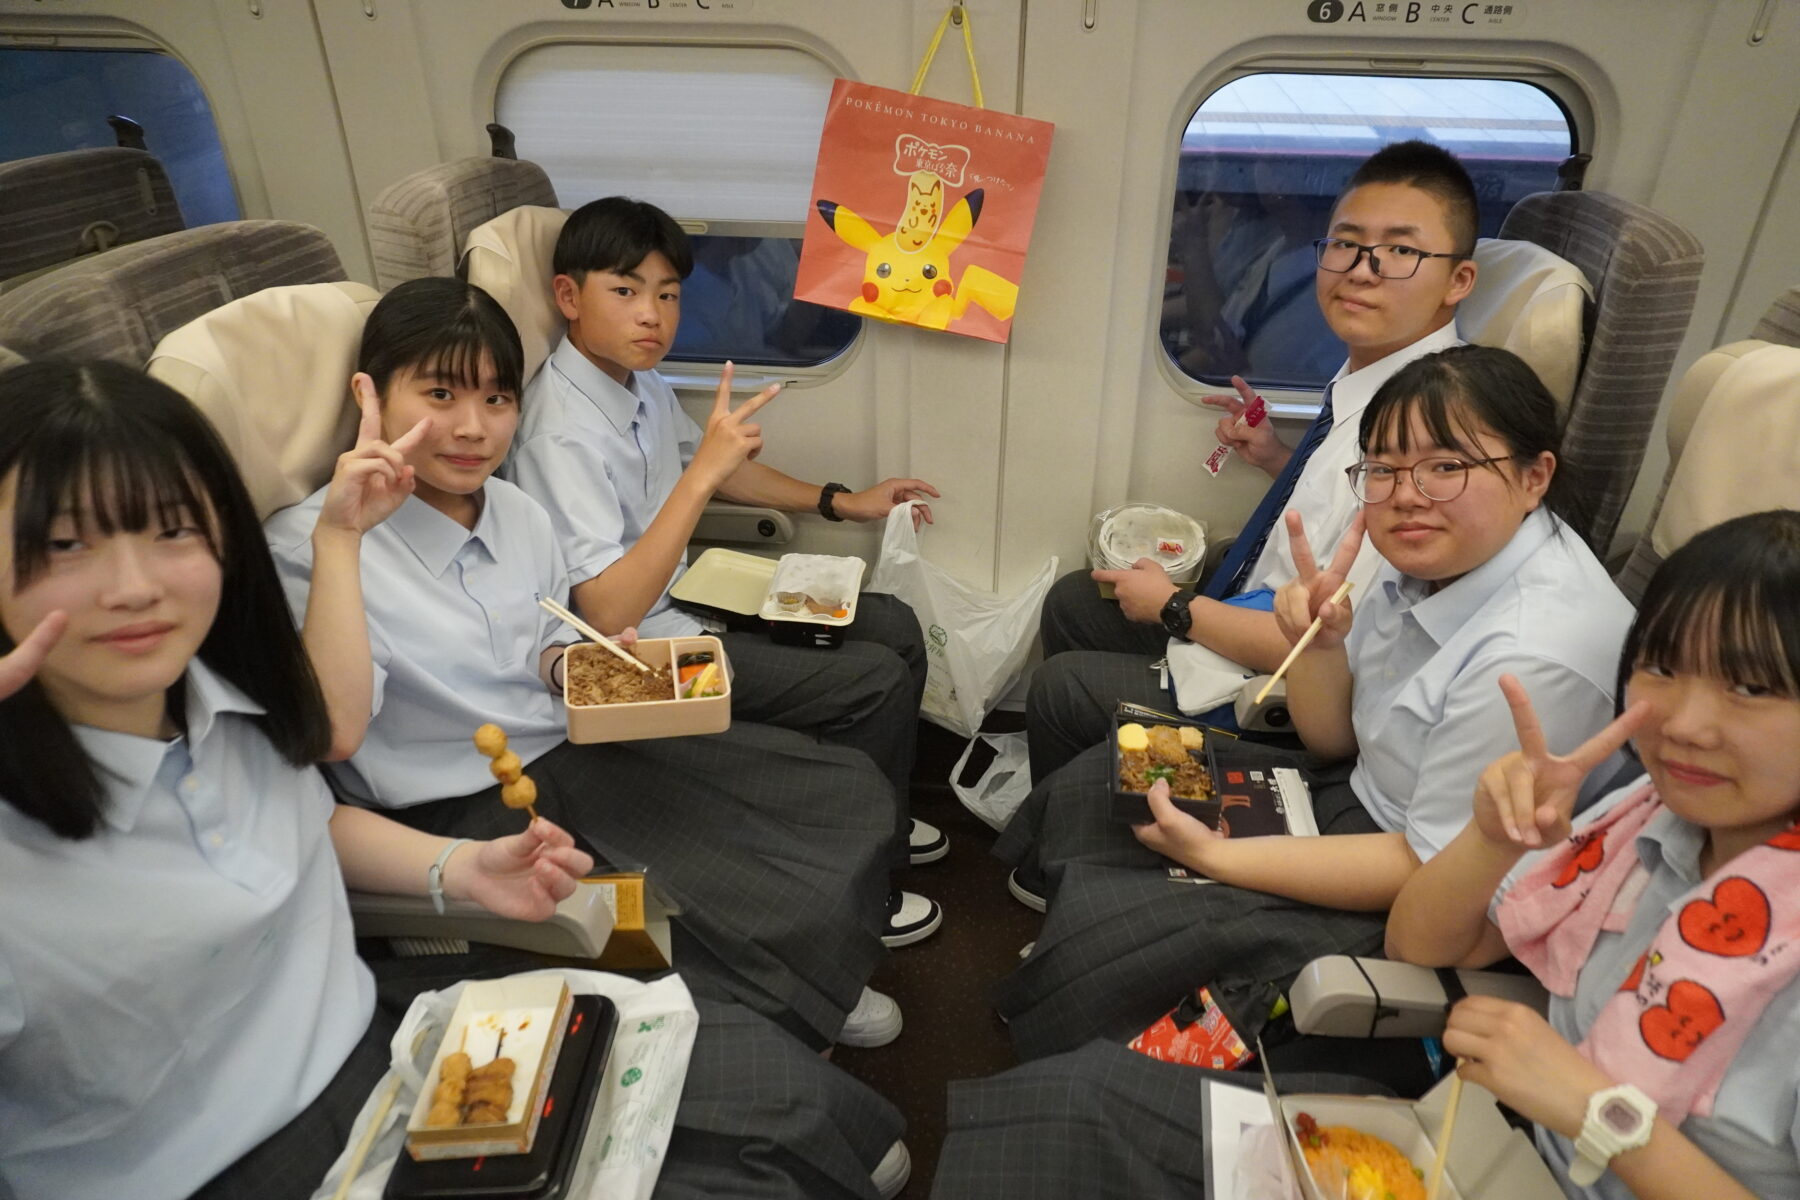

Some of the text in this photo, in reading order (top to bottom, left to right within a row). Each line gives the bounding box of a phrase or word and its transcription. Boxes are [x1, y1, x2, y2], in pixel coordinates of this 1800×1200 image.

[1320, 1, 1513, 24] 6 A 窓側 B 中央 C 通路側
[846, 97, 1035, 144] POKÉMON TOKYO BANANA
[903, 141, 948, 160] ポケモン
